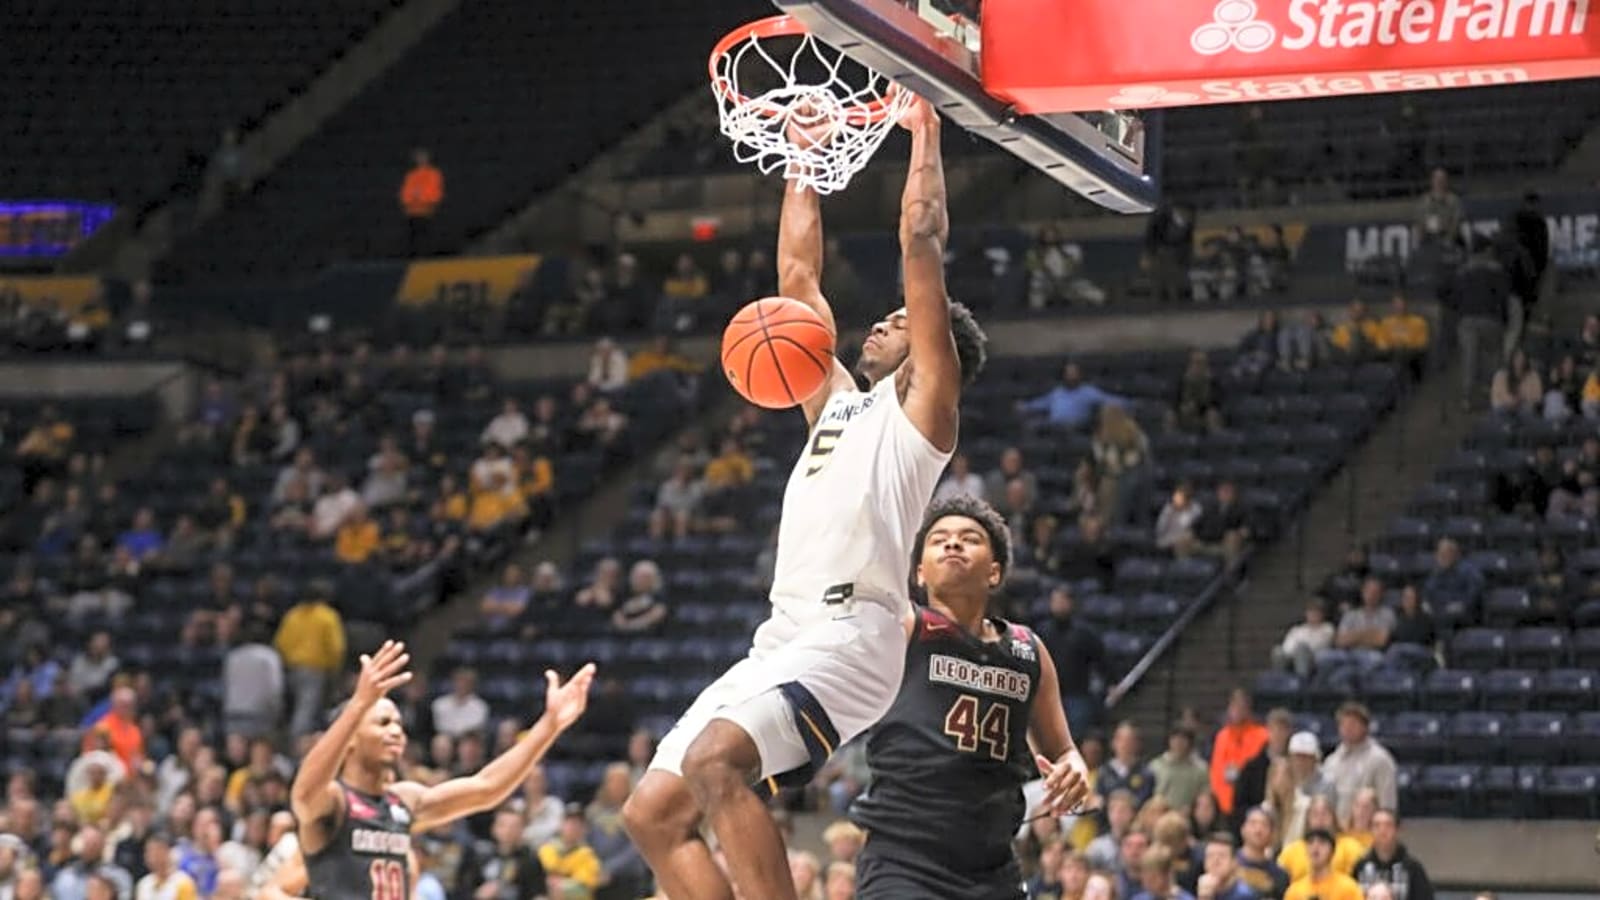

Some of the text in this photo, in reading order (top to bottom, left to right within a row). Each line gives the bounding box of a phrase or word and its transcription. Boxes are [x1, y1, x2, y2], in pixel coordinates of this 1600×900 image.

[805, 428, 844, 478] 5
[929, 654, 1030, 702] LEOPARDS
[944, 694, 1010, 761] 44
